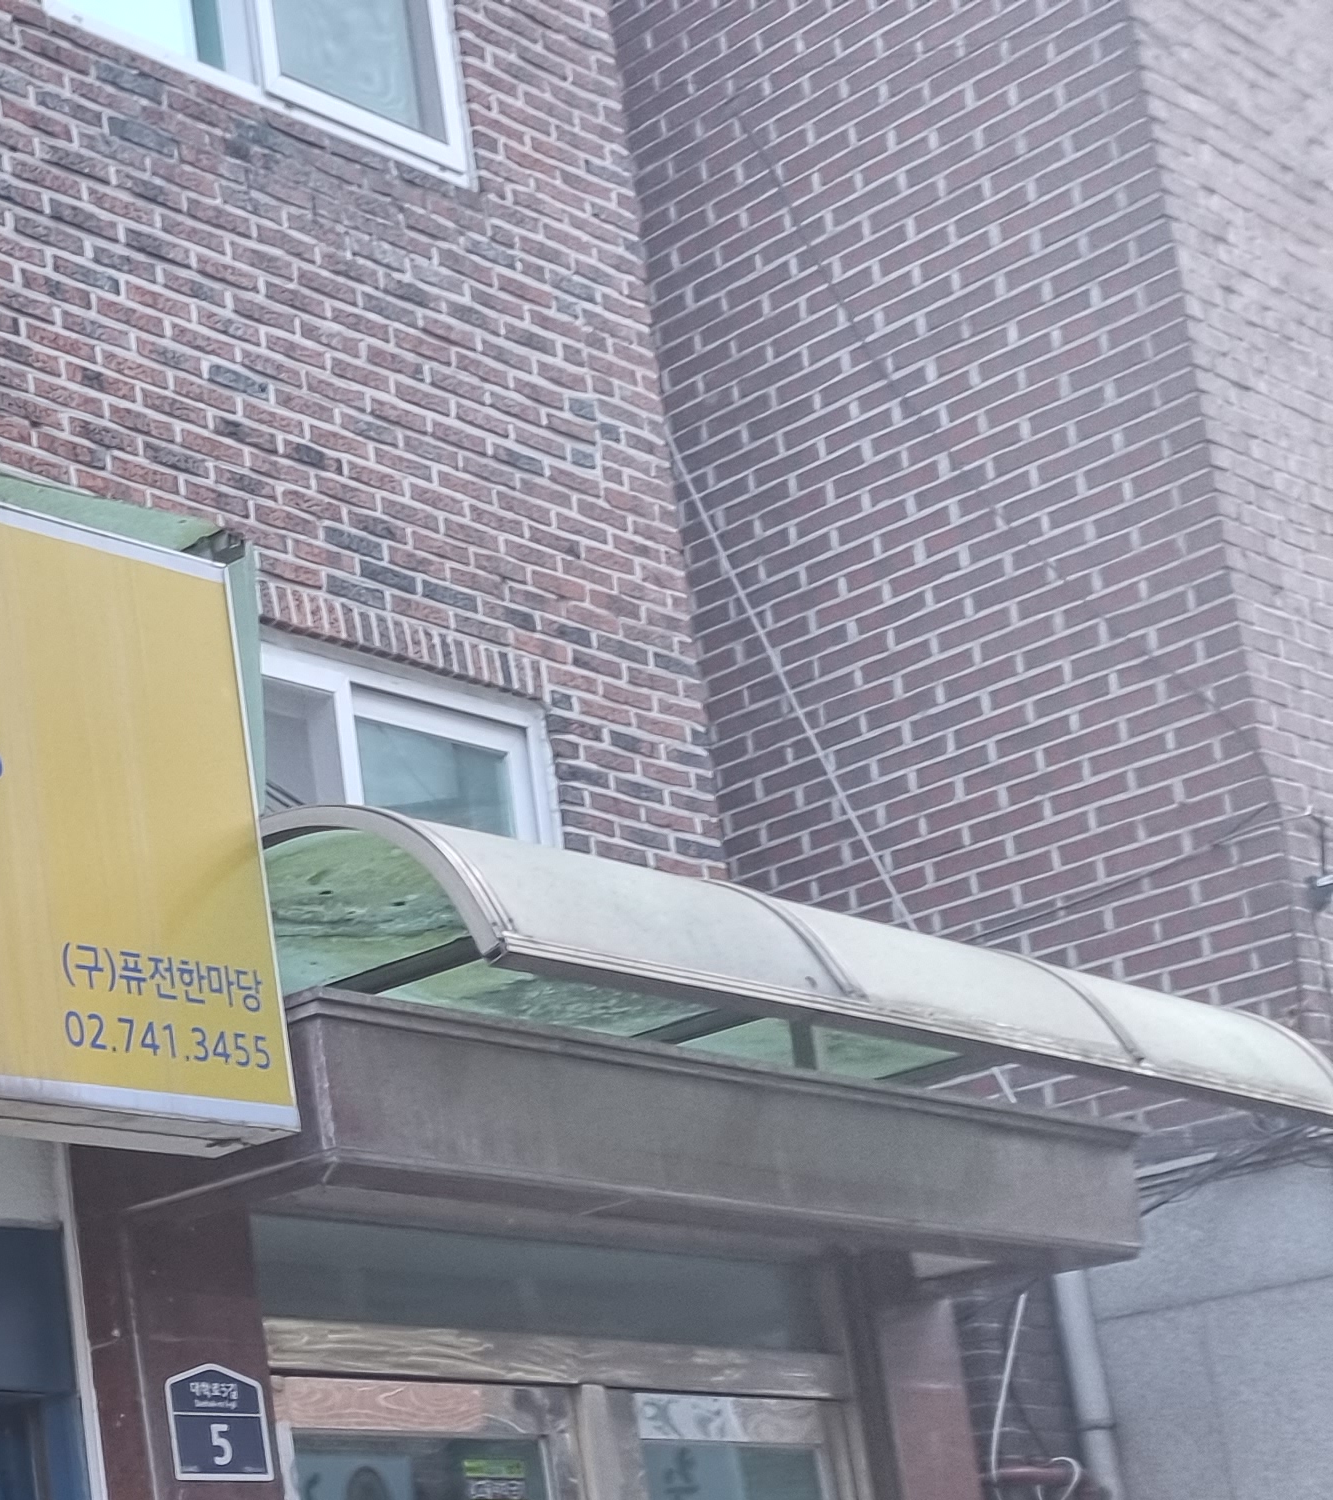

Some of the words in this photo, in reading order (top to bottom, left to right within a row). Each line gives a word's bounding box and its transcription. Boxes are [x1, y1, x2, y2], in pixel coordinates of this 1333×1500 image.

[62, 942, 263, 1012] (구)퓨전한마당
[65, 1010, 271, 1070] 02.741.3455
[209, 1423, 233, 1466] 5
